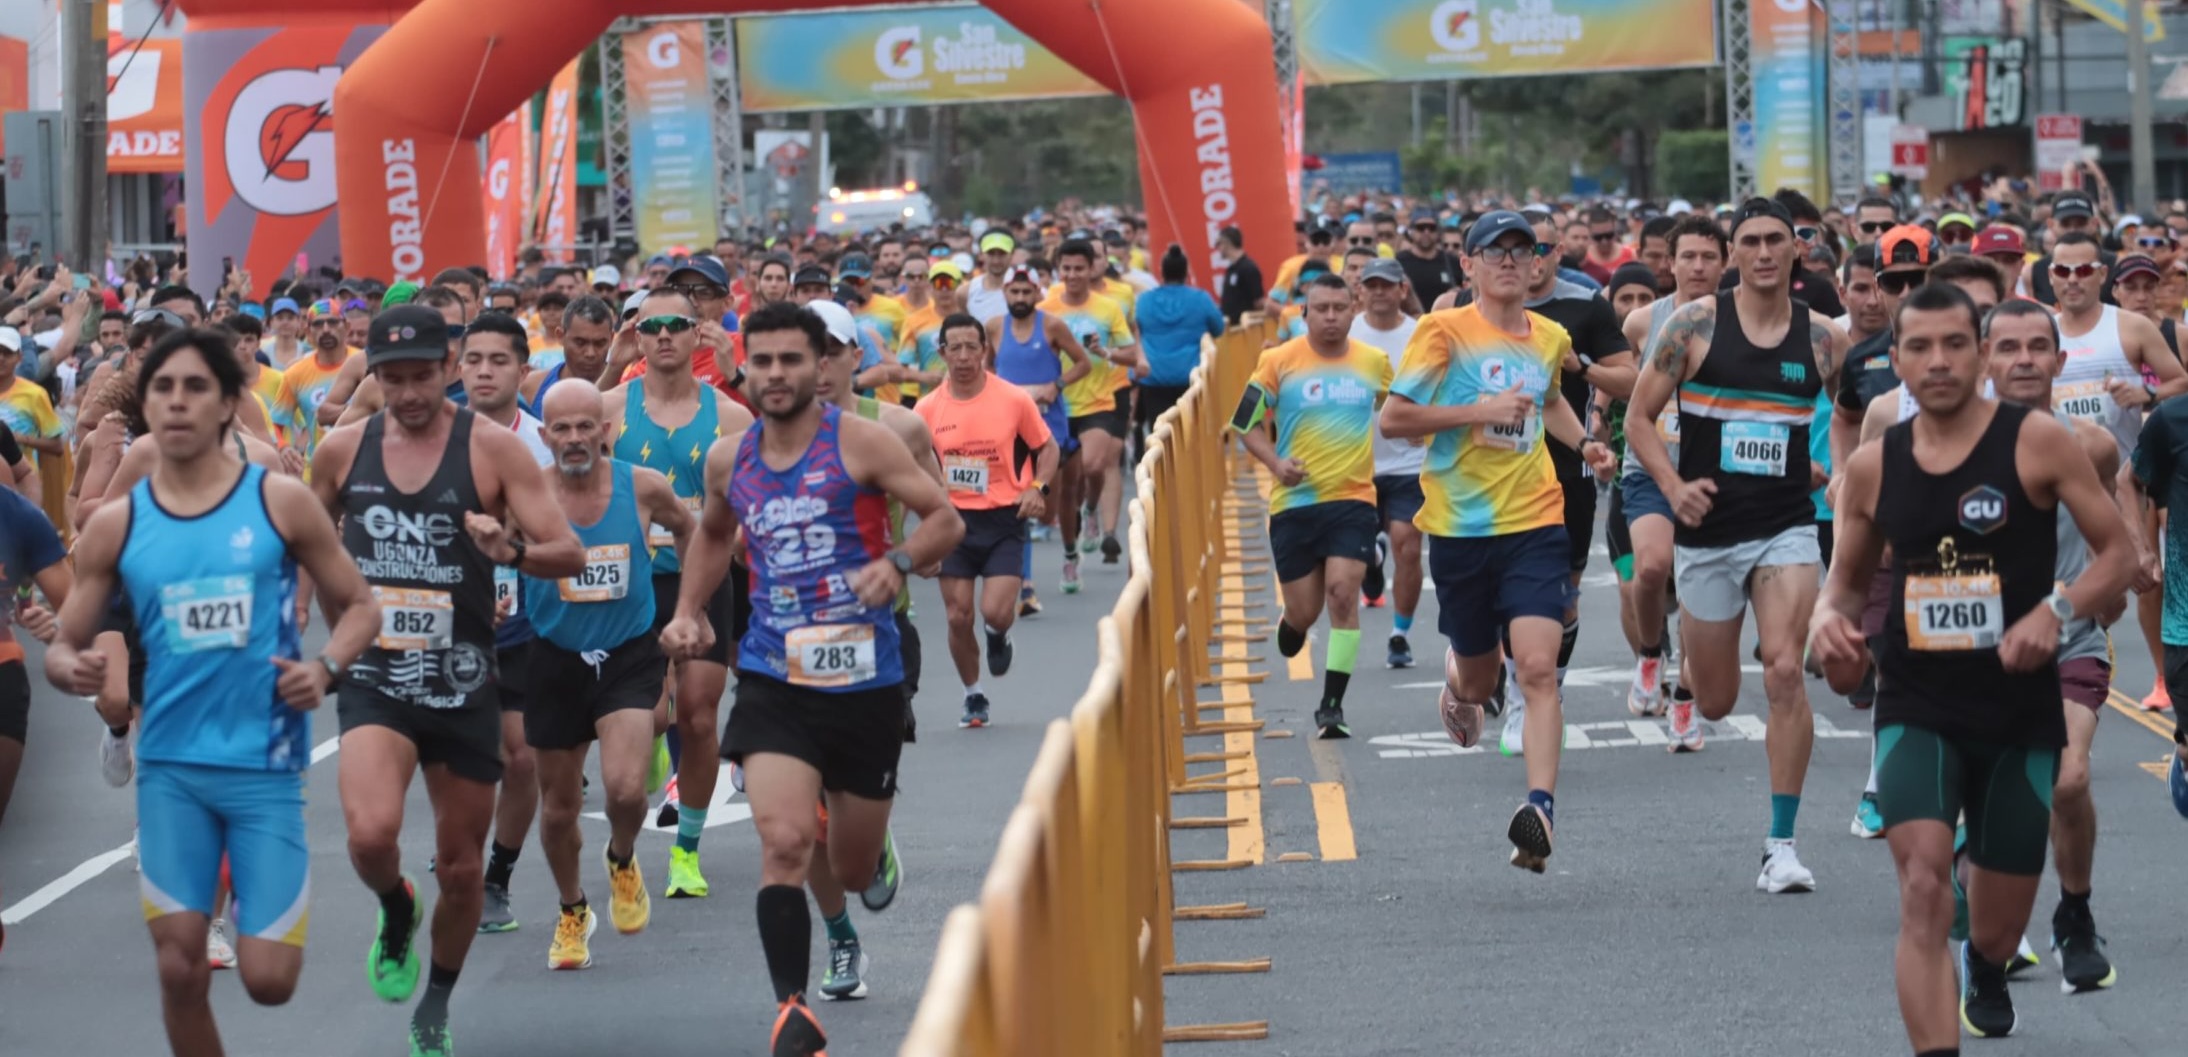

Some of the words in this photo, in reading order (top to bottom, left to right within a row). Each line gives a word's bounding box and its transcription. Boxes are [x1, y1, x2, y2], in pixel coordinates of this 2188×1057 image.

[874, 24, 925, 80] G
[934, 36, 1025, 72] Silvestre
[2063, 397, 2102, 415] 1406
[1735, 440, 1782, 461] 4066
[952, 468, 981, 484] 1427
[1963, 501, 2001, 519] GU
[772, 524, 836, 567] 29
[576, 564, 620, 586] 1625
[187, 601, 245, 631] 4221
[393, 610, 435, 634] 852
[1925, 602, 1987, 629] 1260
[813, 646, 857, 670] 283
